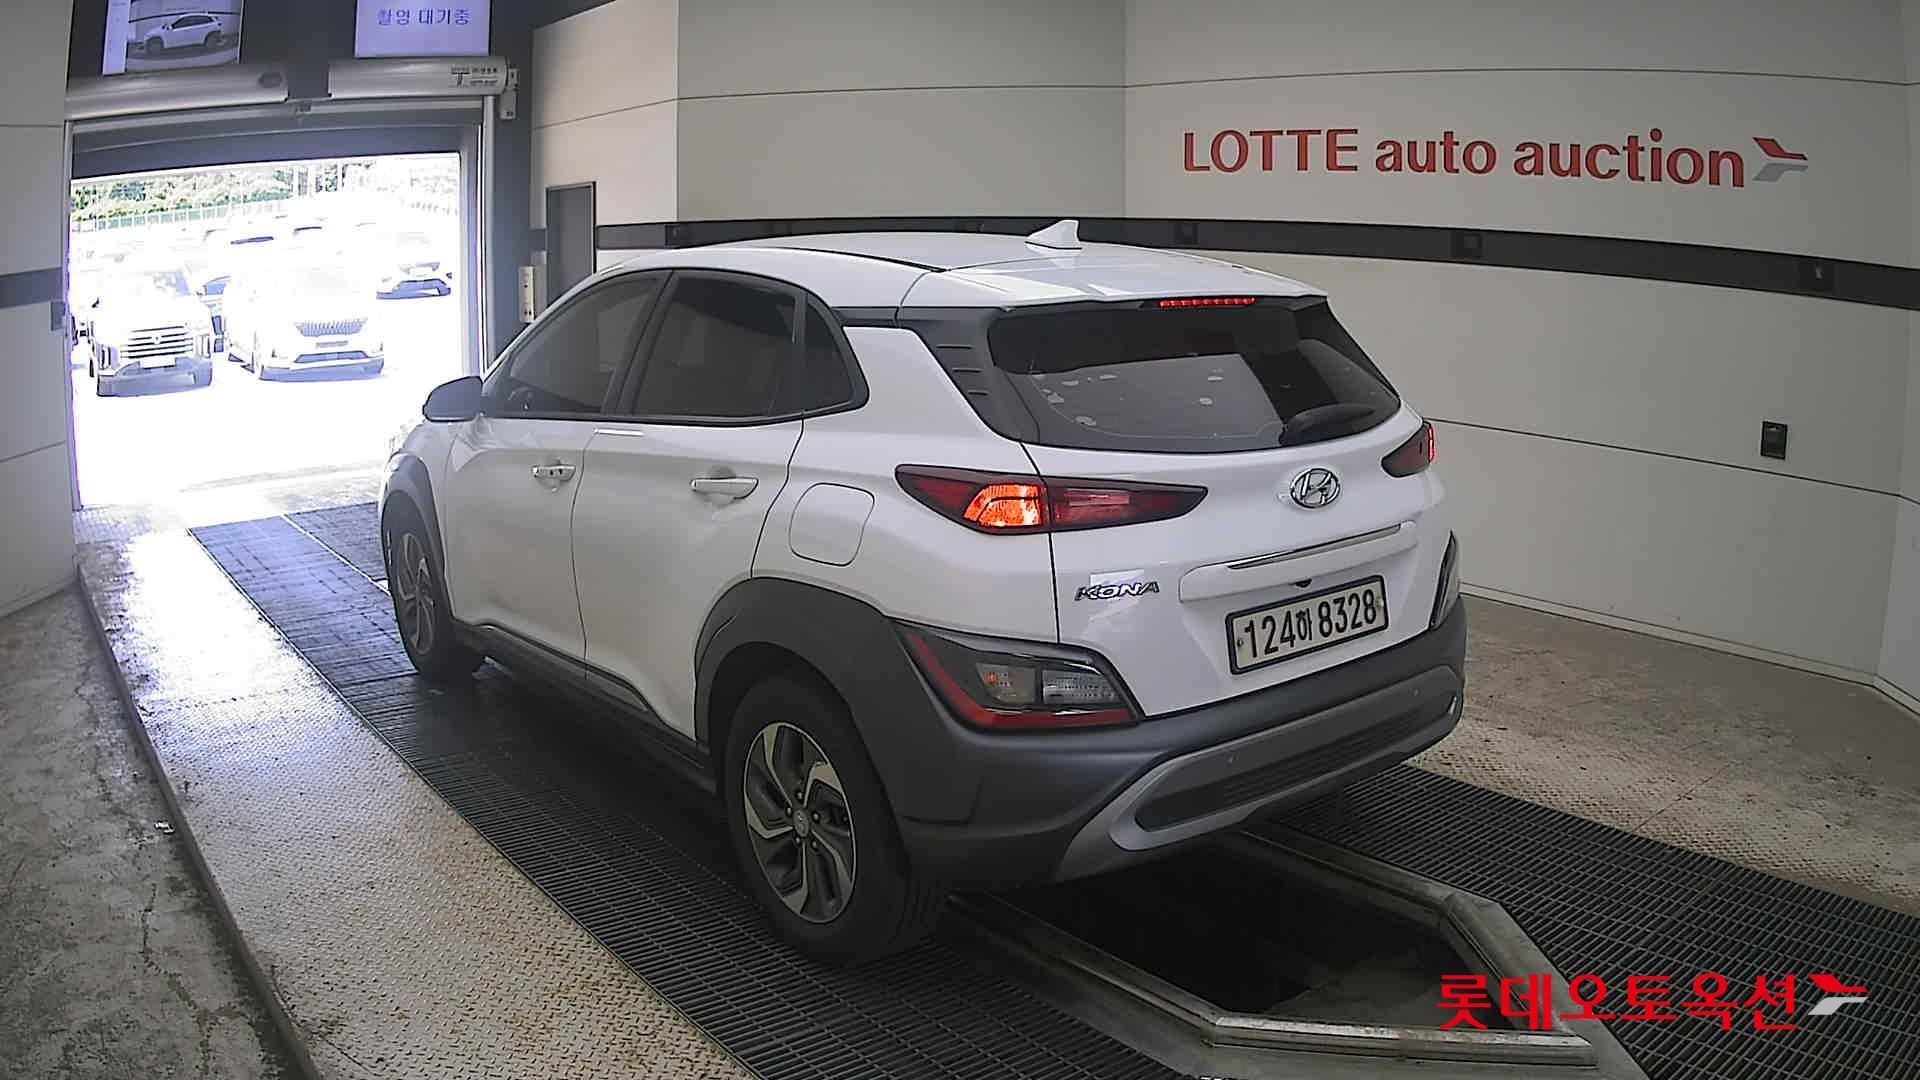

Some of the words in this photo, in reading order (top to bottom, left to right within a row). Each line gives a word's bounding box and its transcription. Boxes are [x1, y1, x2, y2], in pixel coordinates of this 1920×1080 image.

[418, 8, 471, 26] 대기중
[1184, 128, 1359, 174] LOTTE
[1375, 130, 1498, 176] auto
[1513, 127, 1745, 188] auction
[1074, 581, 1160, 602] KONA
[1318, 588, 1377, 638] 8328
